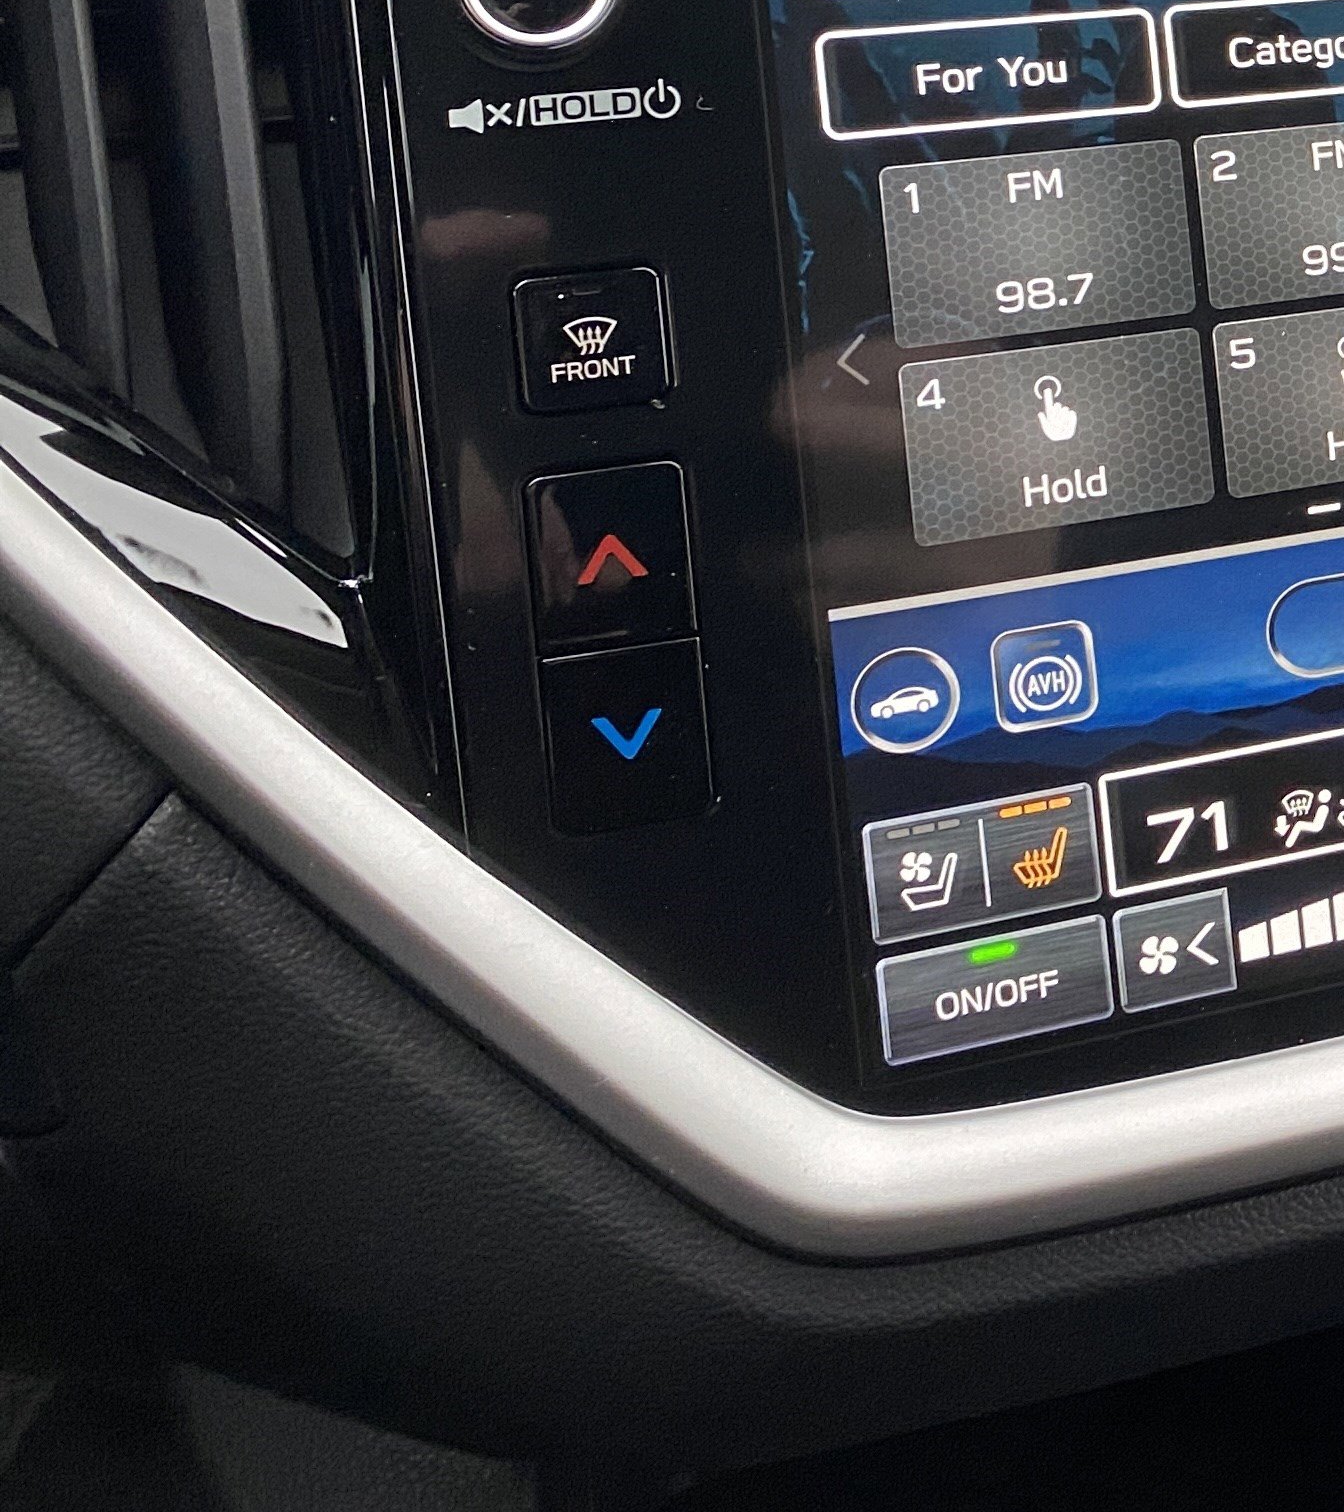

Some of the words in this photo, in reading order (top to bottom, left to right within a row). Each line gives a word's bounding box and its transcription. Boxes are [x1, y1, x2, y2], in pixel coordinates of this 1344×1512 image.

[916, 63, 983, 96] For
[997, 55, 1069, 88] You
[1210, 150, 1238, 182] 2
[902, 182, 920, 214] 1
[1007, 168, 1064, 203] FM
[996, 272, 1094, 313] 98.7
[550, 354, 636, 384] FRONT
[1229, 337, 1256, 370] 5
[916, 378, 946, 410] 4
[1022, 465, 1108, 507] Hold
[1026, 669, 1066, 698] AVH
[1146, 799, 1229, 863] 71
[935, 969, 1058, 1021] ON/OFF
